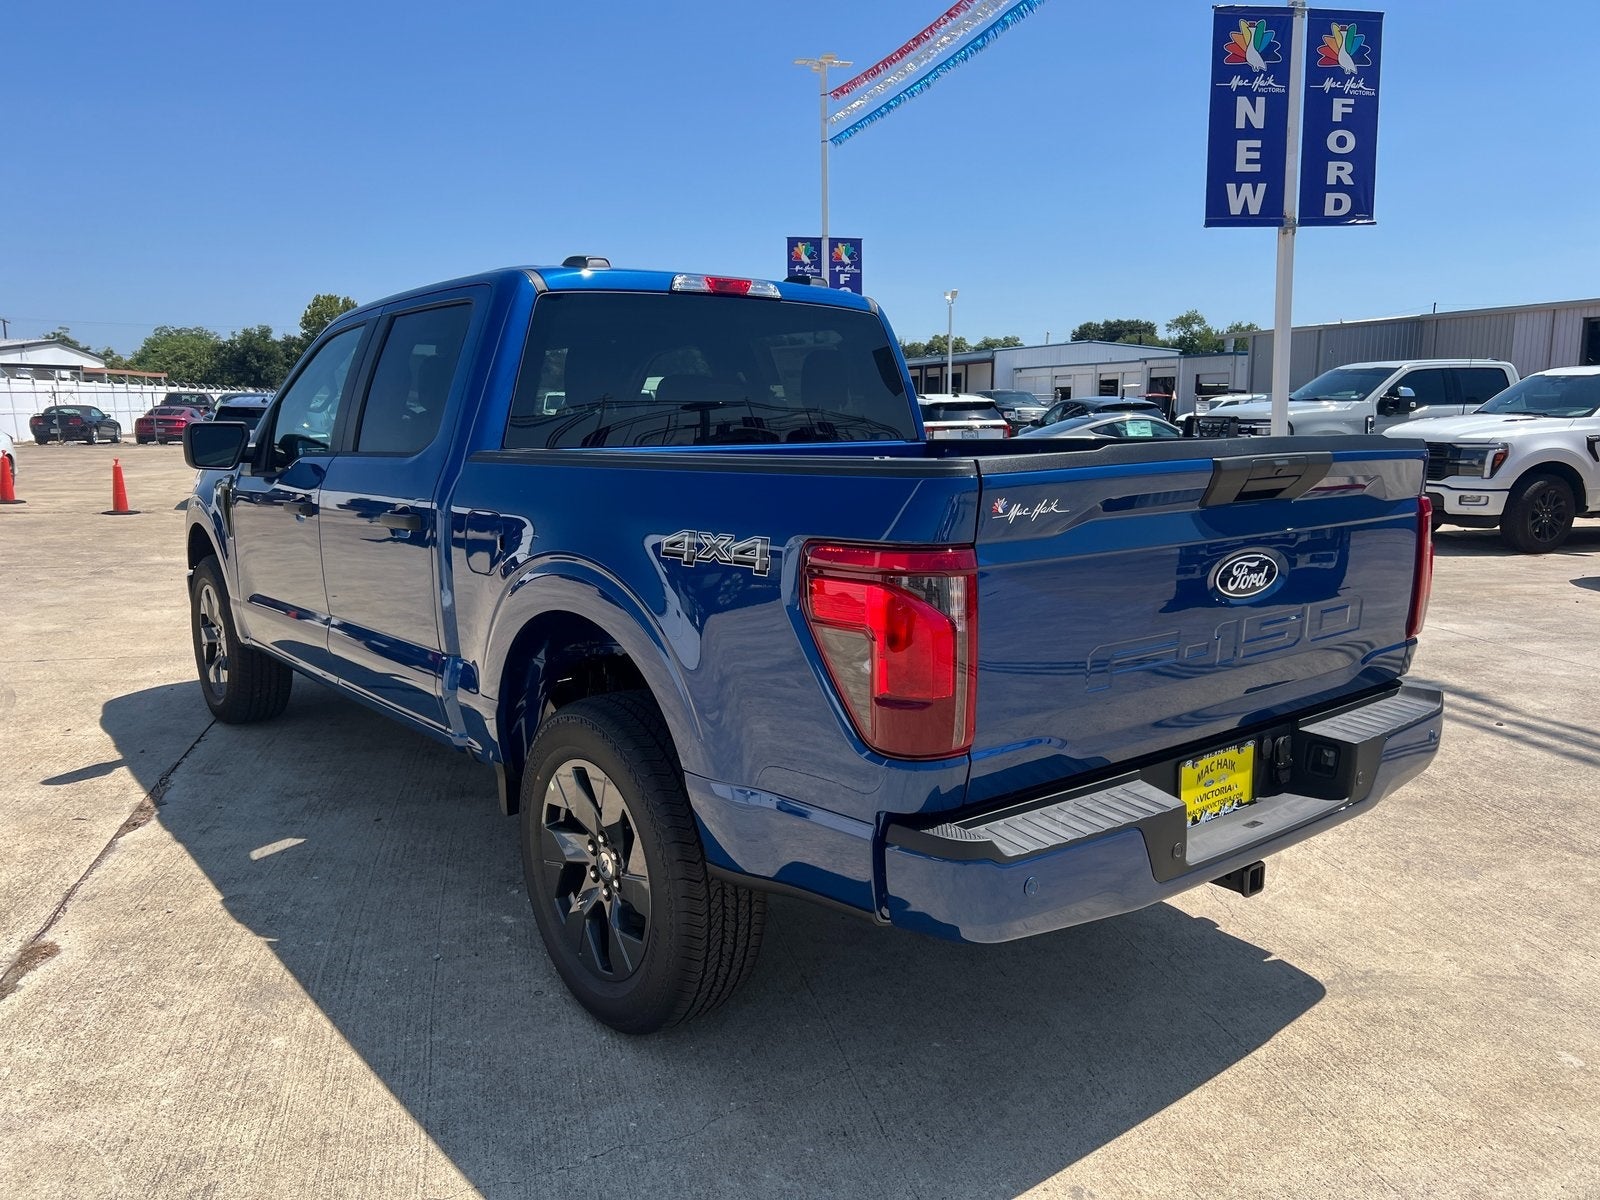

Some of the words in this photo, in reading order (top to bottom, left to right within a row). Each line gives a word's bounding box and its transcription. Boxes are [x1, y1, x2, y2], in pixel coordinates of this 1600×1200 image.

[1216, 75, 1252, 92] Mac
[1251, 74, 1285, 92] Haik
[1310, 77, 1345, 93] Mac
[1343, 76, 1375, 94] Haik
[1226, 96, 1267, 215] NEW
[1323, 98, 1356, 216] FORD
[992, 503, 1031, 524] Mac
[1030, 498, 1070, 522] Haik
[1227, 560, 1269, 591] Ford
[1085, 595, 1363, 693] F-150
[1196, 761, 1215, 785] MAC
[1216, 758, 1236, 773] HAIK
[1199, 784, 1233, 802] VICTORIA
